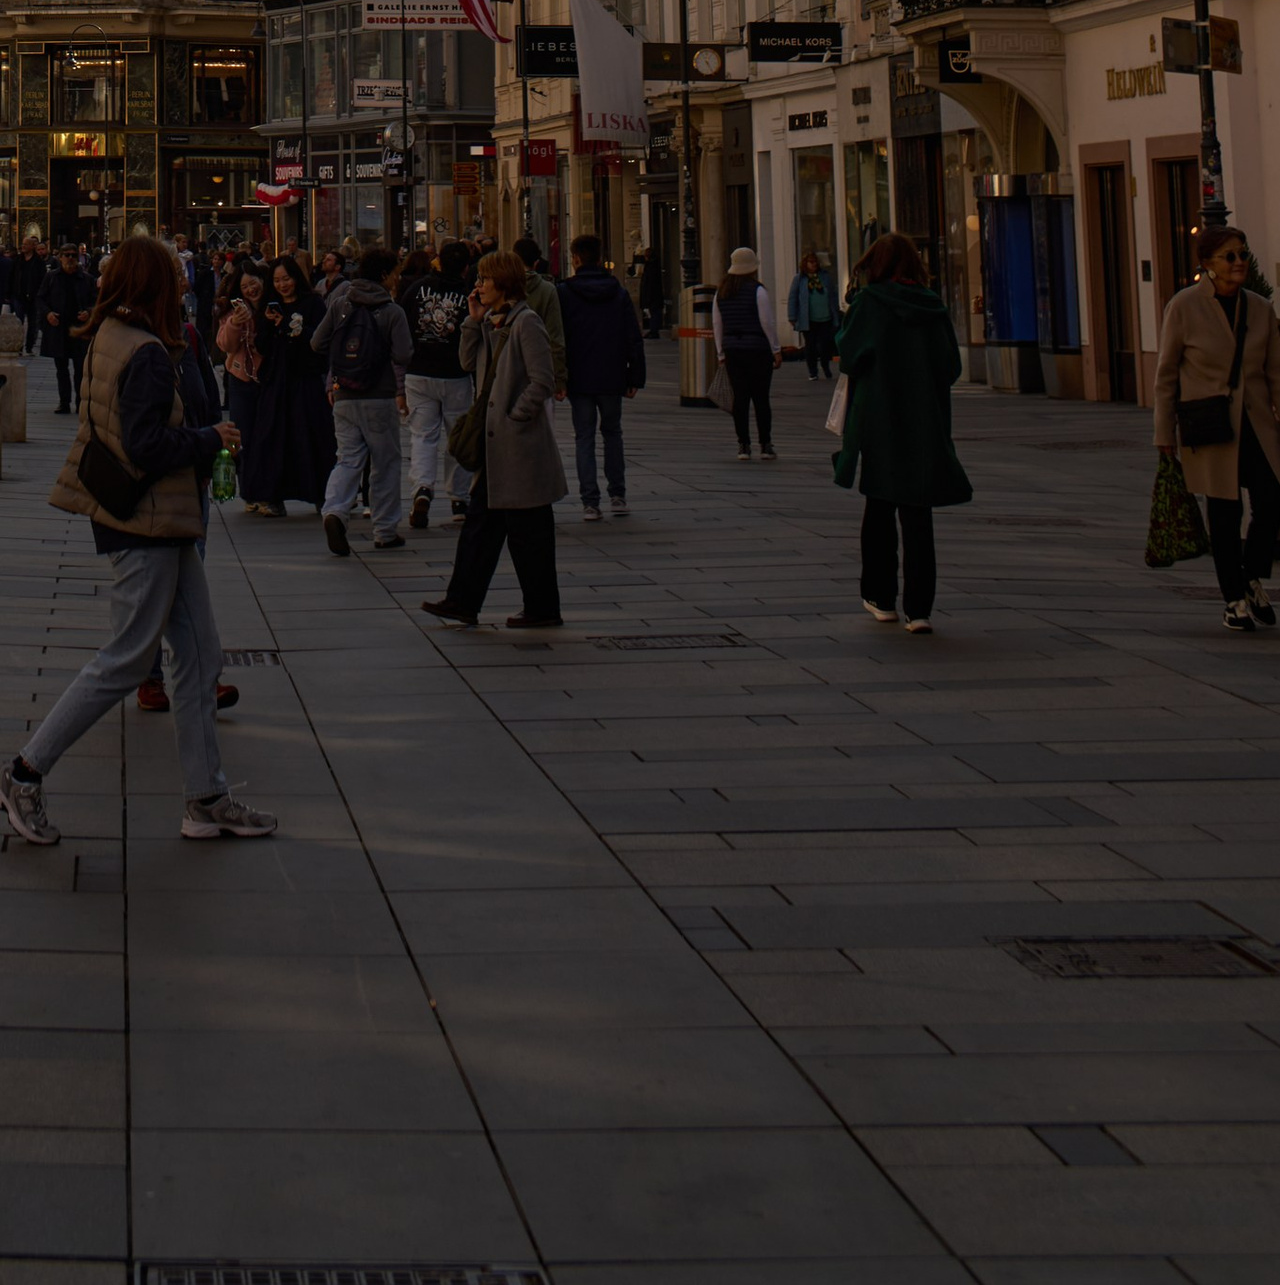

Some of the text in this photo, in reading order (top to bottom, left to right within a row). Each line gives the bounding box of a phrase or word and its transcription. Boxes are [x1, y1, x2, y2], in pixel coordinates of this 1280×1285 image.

[525, 42, 577, 52] IEBES
[759, 37, 833, 47] MICHAEL KORS
[586, 112, 648, 133] LISKA
[319, 165, 334, 179] GIFTS
